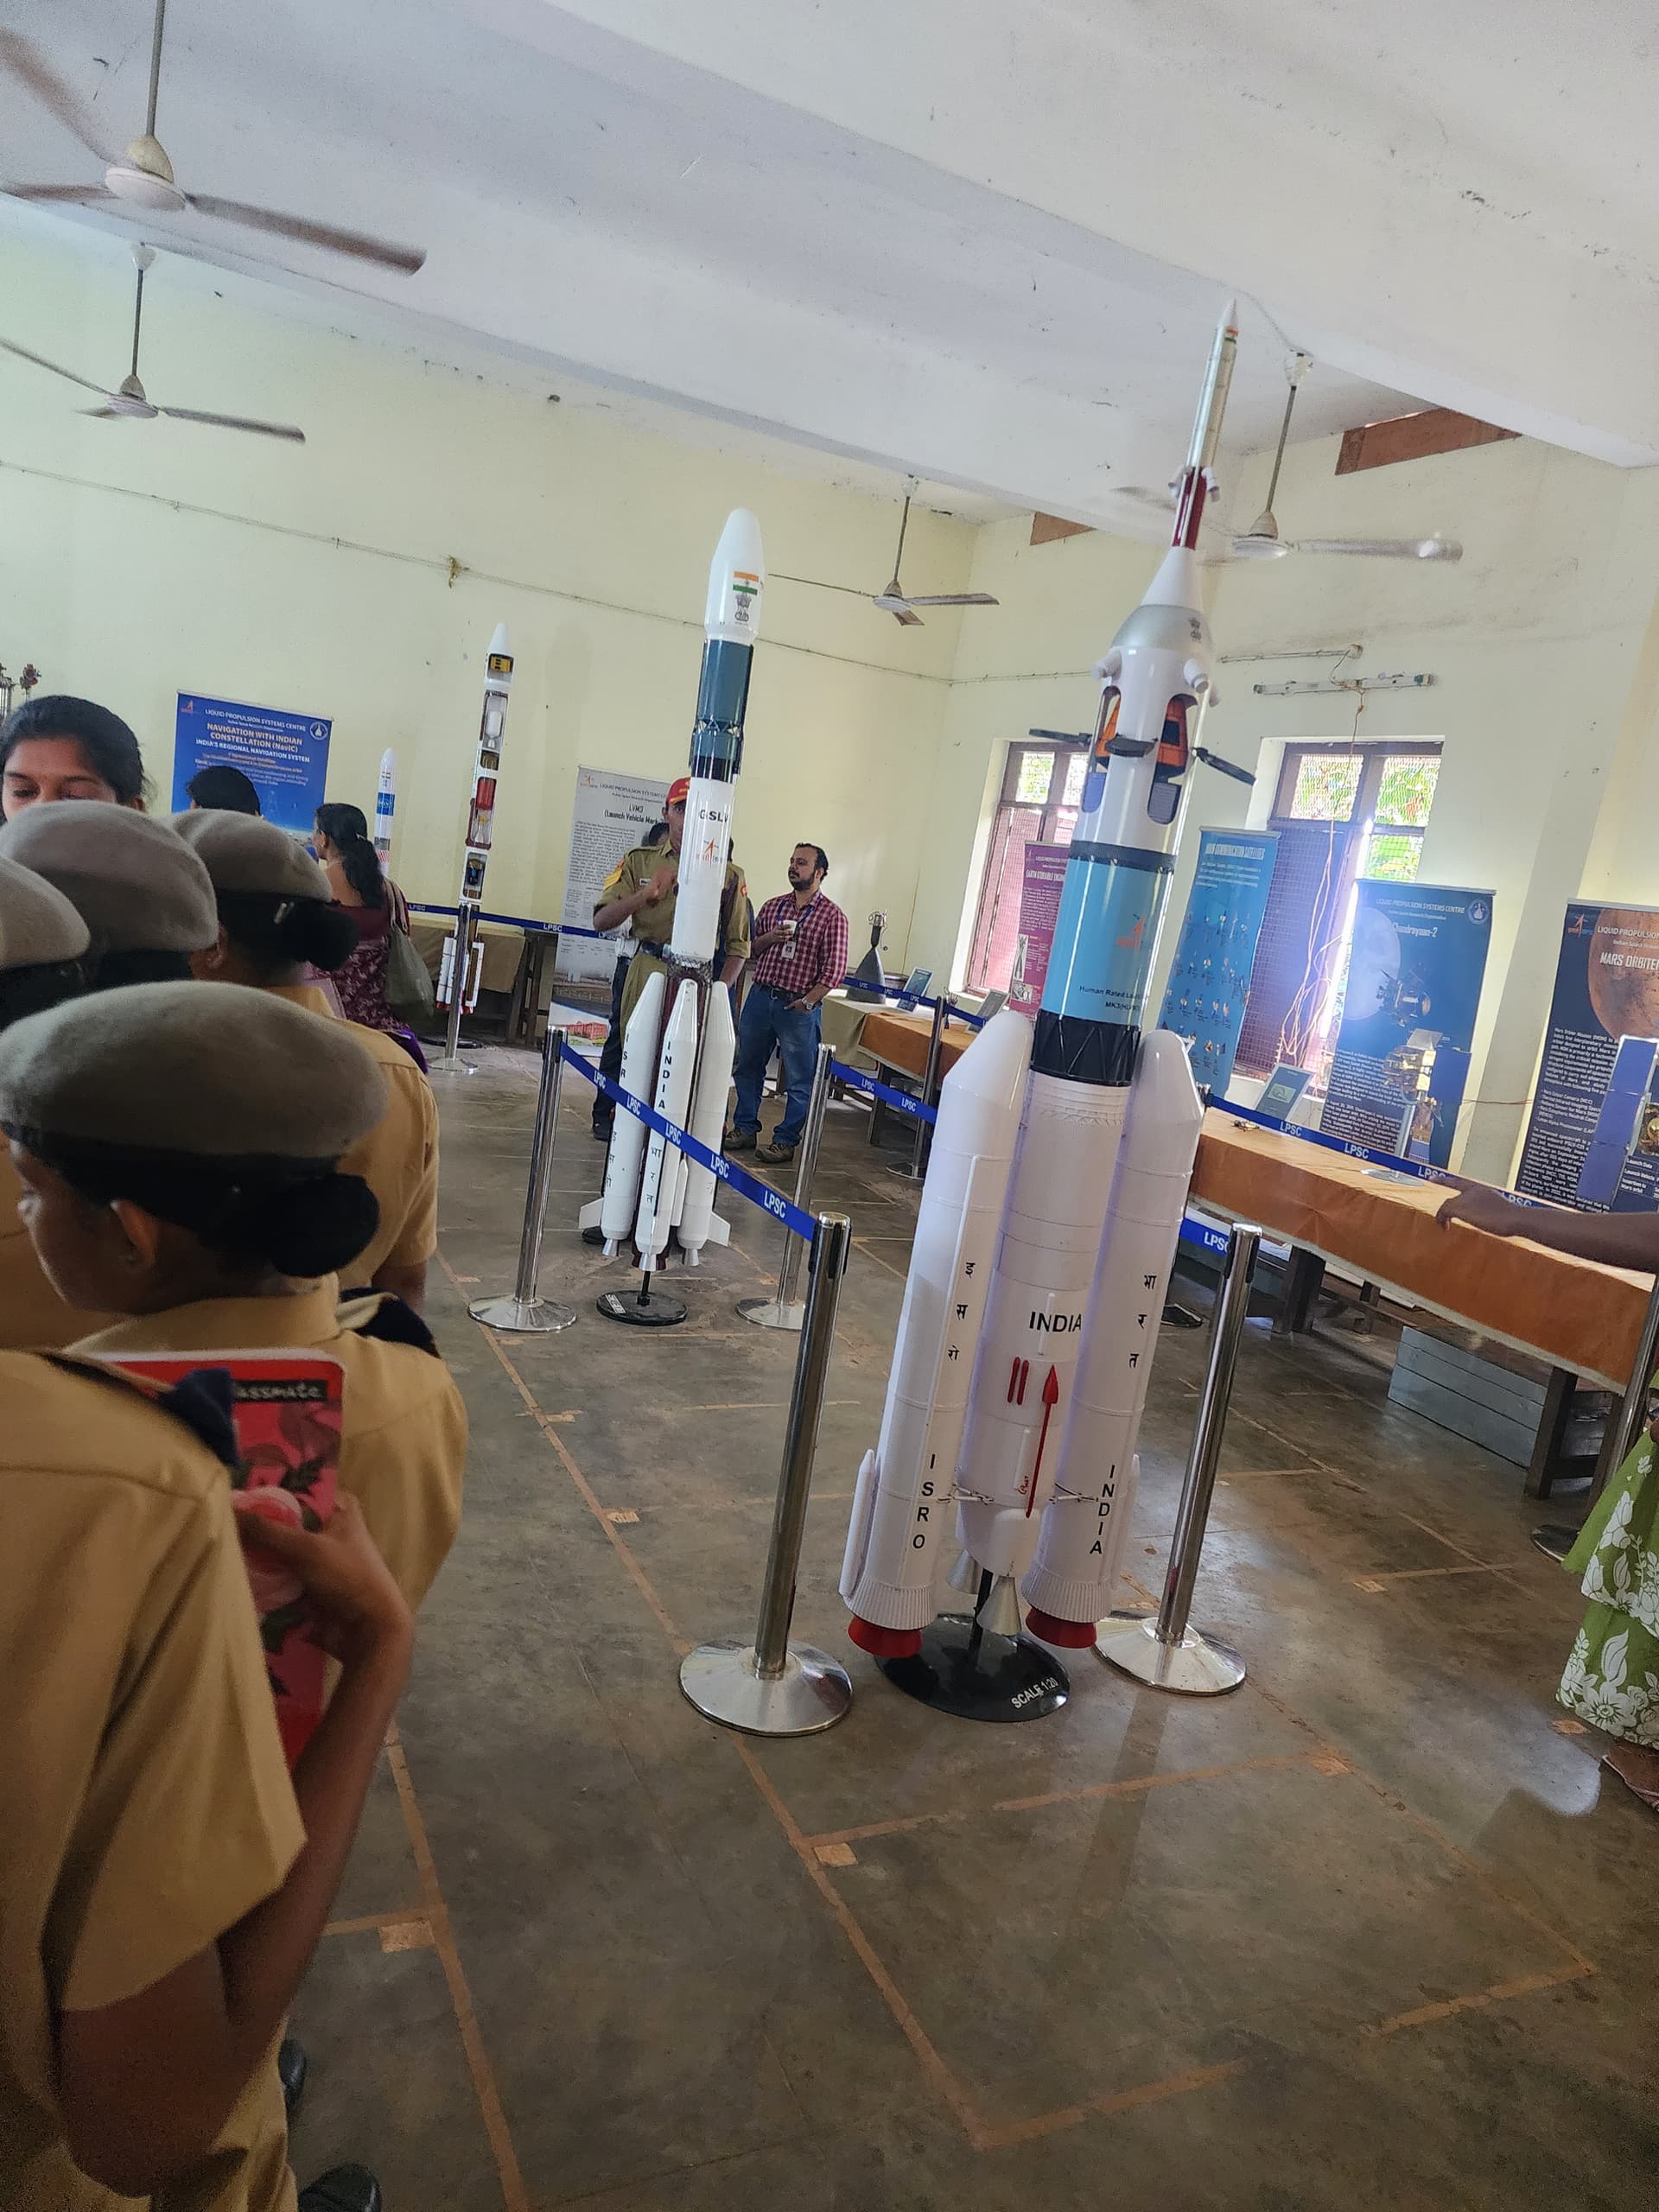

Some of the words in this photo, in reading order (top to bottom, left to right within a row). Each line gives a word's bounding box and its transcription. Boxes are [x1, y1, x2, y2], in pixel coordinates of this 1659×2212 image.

[205, 709, 225, 717] LIQUID
[225, 713, 260, 723] PROPULSION
[261, 719, 285, 728] SYSTEMS
[285, 722, 307, 732] CENTRE
[207, 722, 255, 738] NAVIGATION
[255, 731, 275, 741] WITH
[276, 734, 302, 746] INDIAN
[210, 732, 271, 748] CONSTELLATION
[272, 743, 299, 753] (NavIC)
[195, 739, 219, 748] INDIA'S
[219, 743, 251, 753] REGIONAL
[251, 747, 287, 760] NAVIGATION
[288, 754, 310, 763] SYSTEM
[604, 809, 626, 820] (Launch
[626, 812, 645, 823] Vehicle
[629, 804, 644, 813] LVM3
[699, 809, 728, 823] GSLV
[1392, 900, 1422, 909] PROPULSION
[1422, 903, 1445, 912] SYSTEMS
[1445, 906, 1465, 914] CENTRE
[543, 923, 563, 931] LPSC
[1597, 925, 1619, 935] LIQUID
[1600, 952, 1624, 966] MARS
[1079, 985, 1104, 995] Human
[1106, 988, 1125, 999] Rated
[620, 1033, 629, 1078] ISR
[658, 1041, 672, 1109] INDIA
[861, 1077, 875, 1092] LPSC
[901, 1097, 917, 1112] LPSC
[594, 1070, 607, 1089] LPSC
[627, 1094, 641, 1116] LPSC
[665, 1122, 682, 1145] LPSC
[710, 1154, 730, 1179] LPSC
[764, 1190, 786, 1218] LPSC
[1280, 1120, 1303, 1137] LPSC
[1344, 1142, 1370, 1160] LPSC
[1626, 1158, 1643, 1166] Launch
[1624, 1168, 1641, 1177] Launch
[1640, 1173, 1656, 1181] Vehicle
[947, 1262, 976, 1361] इसरो
[1029, 1312, 1082, 1332] INDIA
[1128, 1274, 1157, 1369] भारत
[235, 1382, 320, 1399] assmate
[912, 1453, 936, 1549] ISRO
[1090, 1465, 1116, 1555] INDIA
[1011, 1684, 1044, 1709] SCALE
[1040, 1676, 1059, 1690] 1:20
